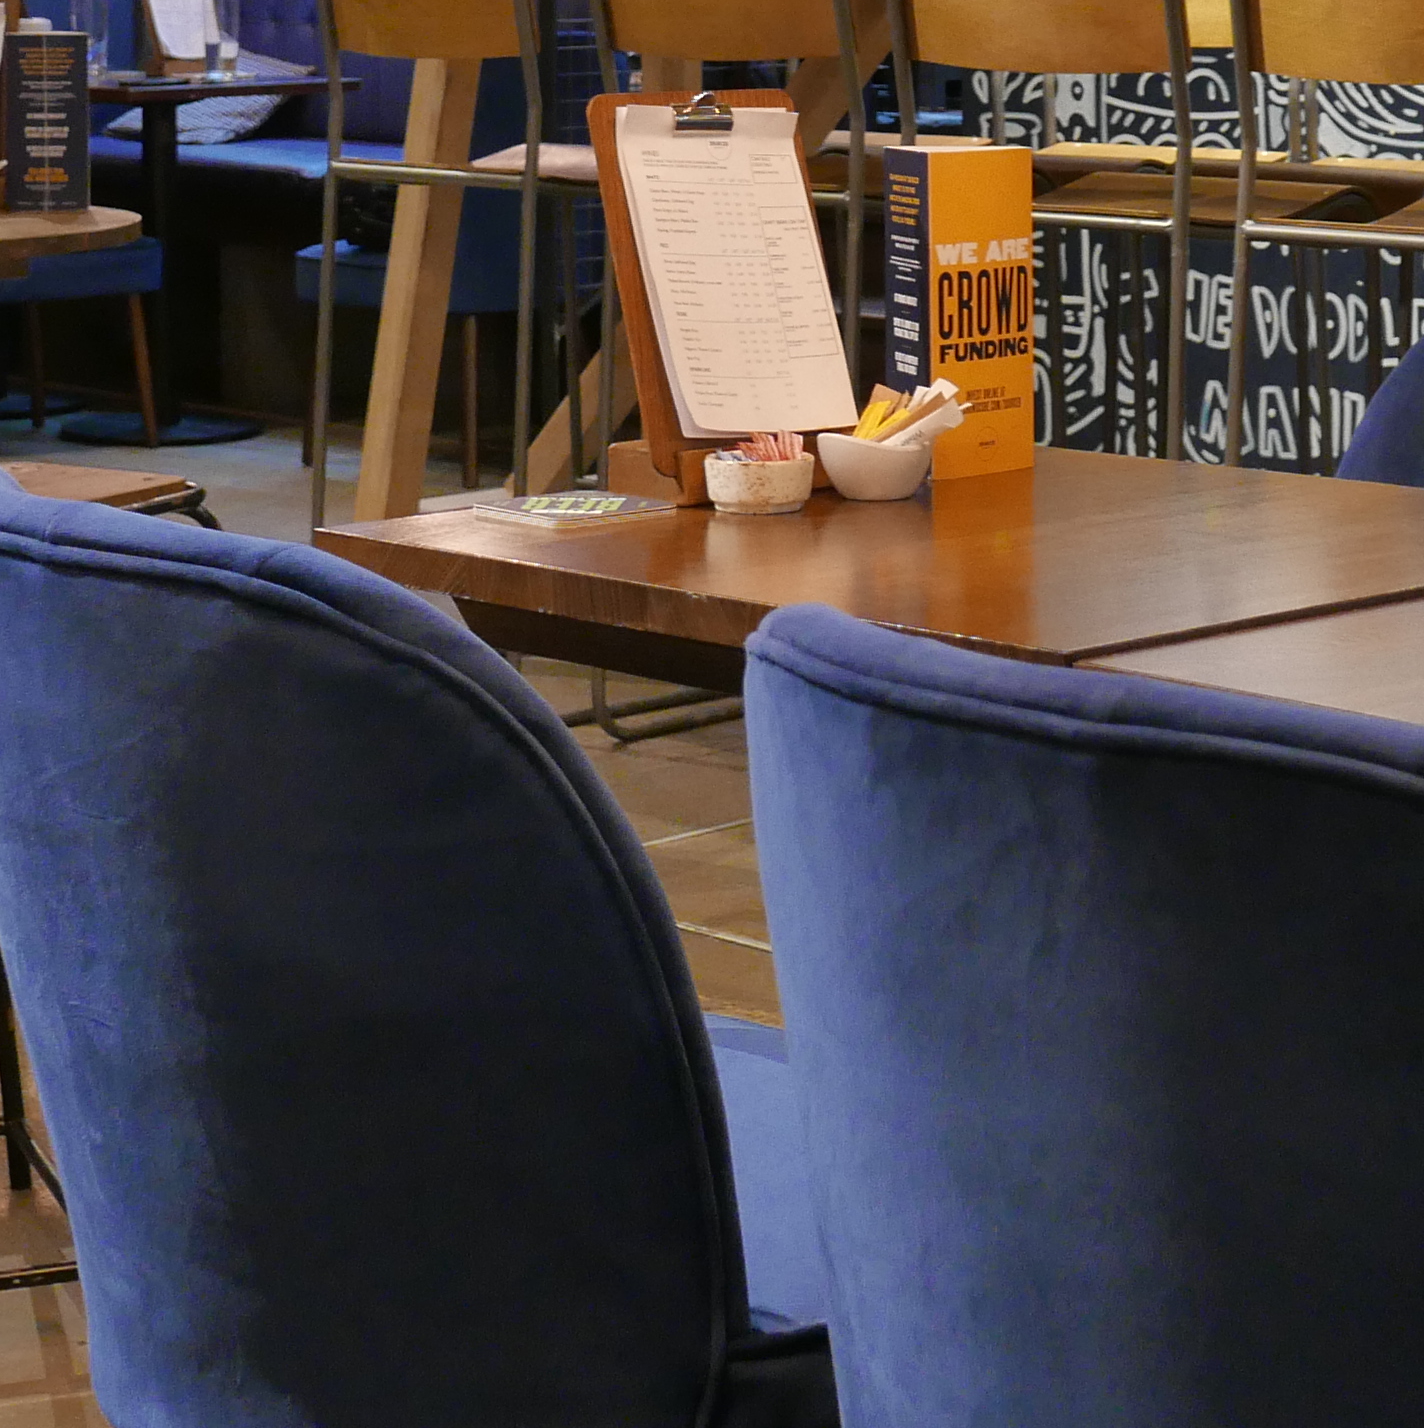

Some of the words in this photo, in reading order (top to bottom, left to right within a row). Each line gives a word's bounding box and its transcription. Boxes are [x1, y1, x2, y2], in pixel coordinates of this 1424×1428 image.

[935, 242, 978, 266] WE
[985, 237, 1030, 262] ARE
[938, 265, 1029, 341] CROWD
[939, 337, 1029, 365] FUNDING
